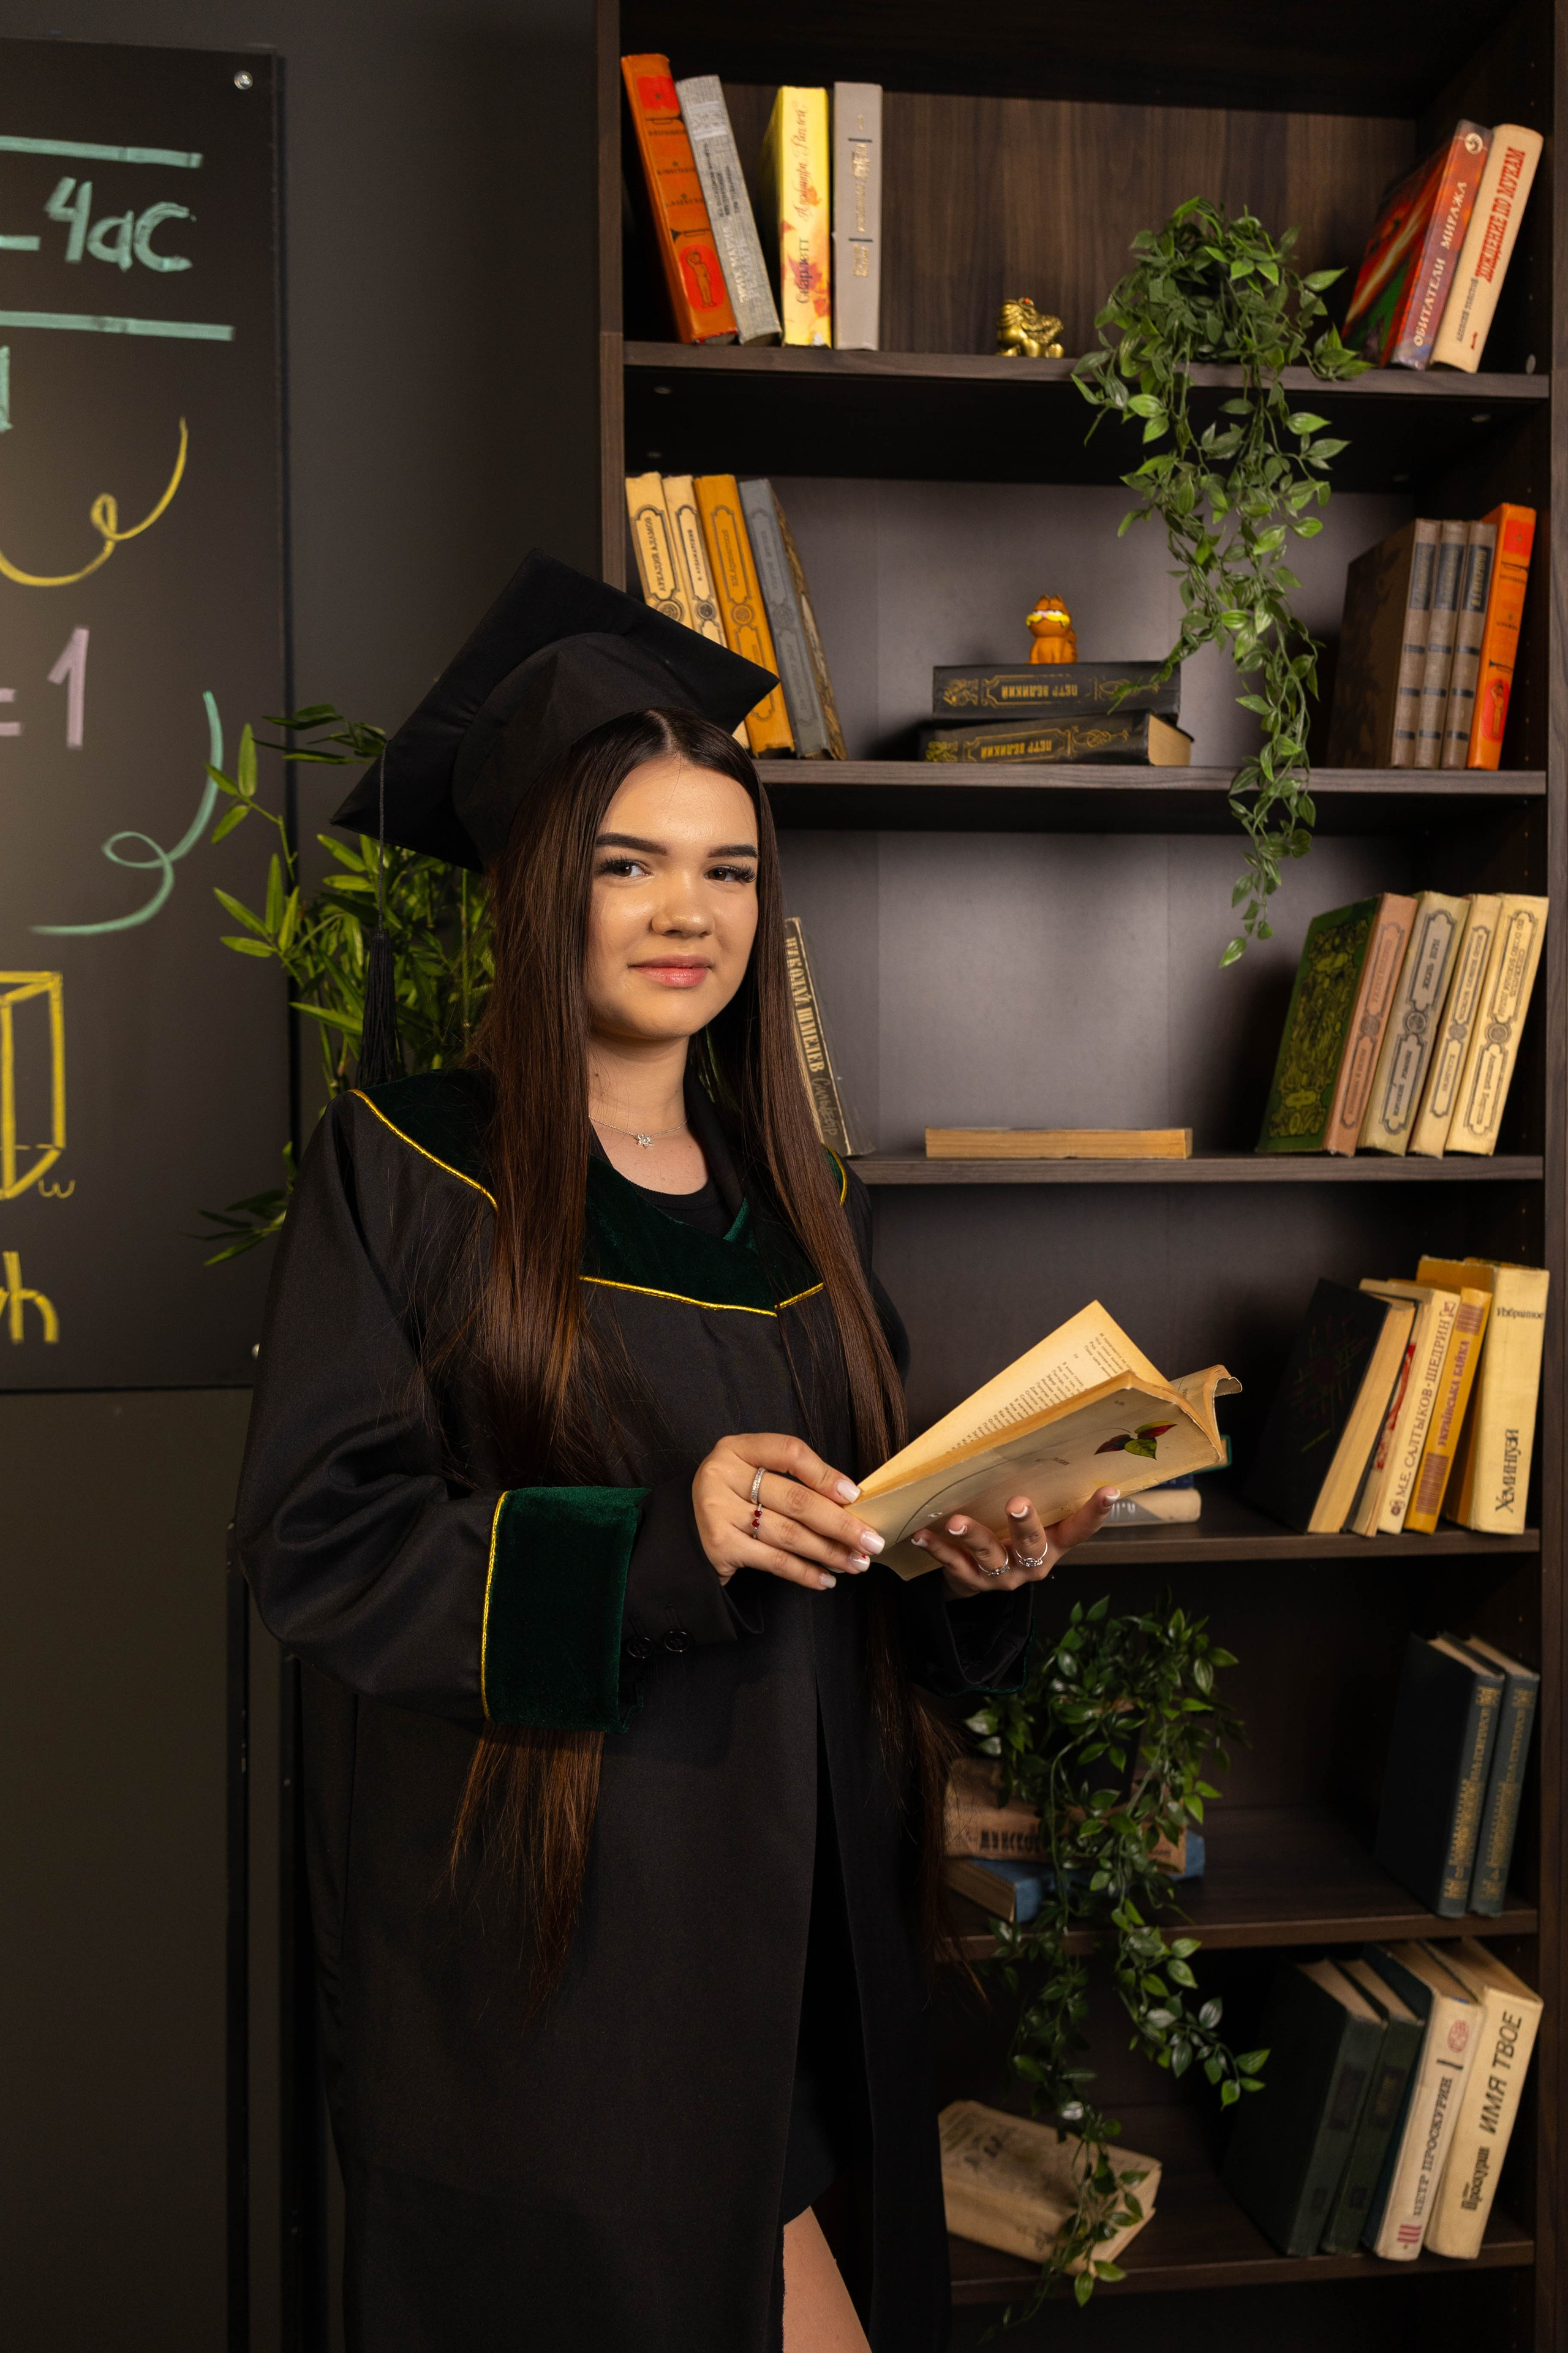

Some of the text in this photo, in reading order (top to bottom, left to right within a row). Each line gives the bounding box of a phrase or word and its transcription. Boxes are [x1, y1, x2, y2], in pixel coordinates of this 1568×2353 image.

[1475, 146, 1526, 284] ХОЖДЕНИЕ ПО МУКАМ
[796, 238, 811, 304] Скарлетт
[1413, 181, 1468, 347] ОБИТАТЕЛИ МИРАЖА
[1001, 683, 1079, 699] ПЕТР ВЕЛИКИЙ
[980, 739, 1053, 759] ПЕТР ВЕЛИКИЙ
[1496, 1306, 1544, 1321] Избранное
[1438, 1340, 1471, 1447] УКРАЇНСЬКА БАЙКА
[1494, 1428, 1520, 1514] Хемингуэй
[1479, 2011, 1523, 2135] ИМЯ ТВОЕ
[1422, 2075, 1453, 2172] ПРОСКУРИН
